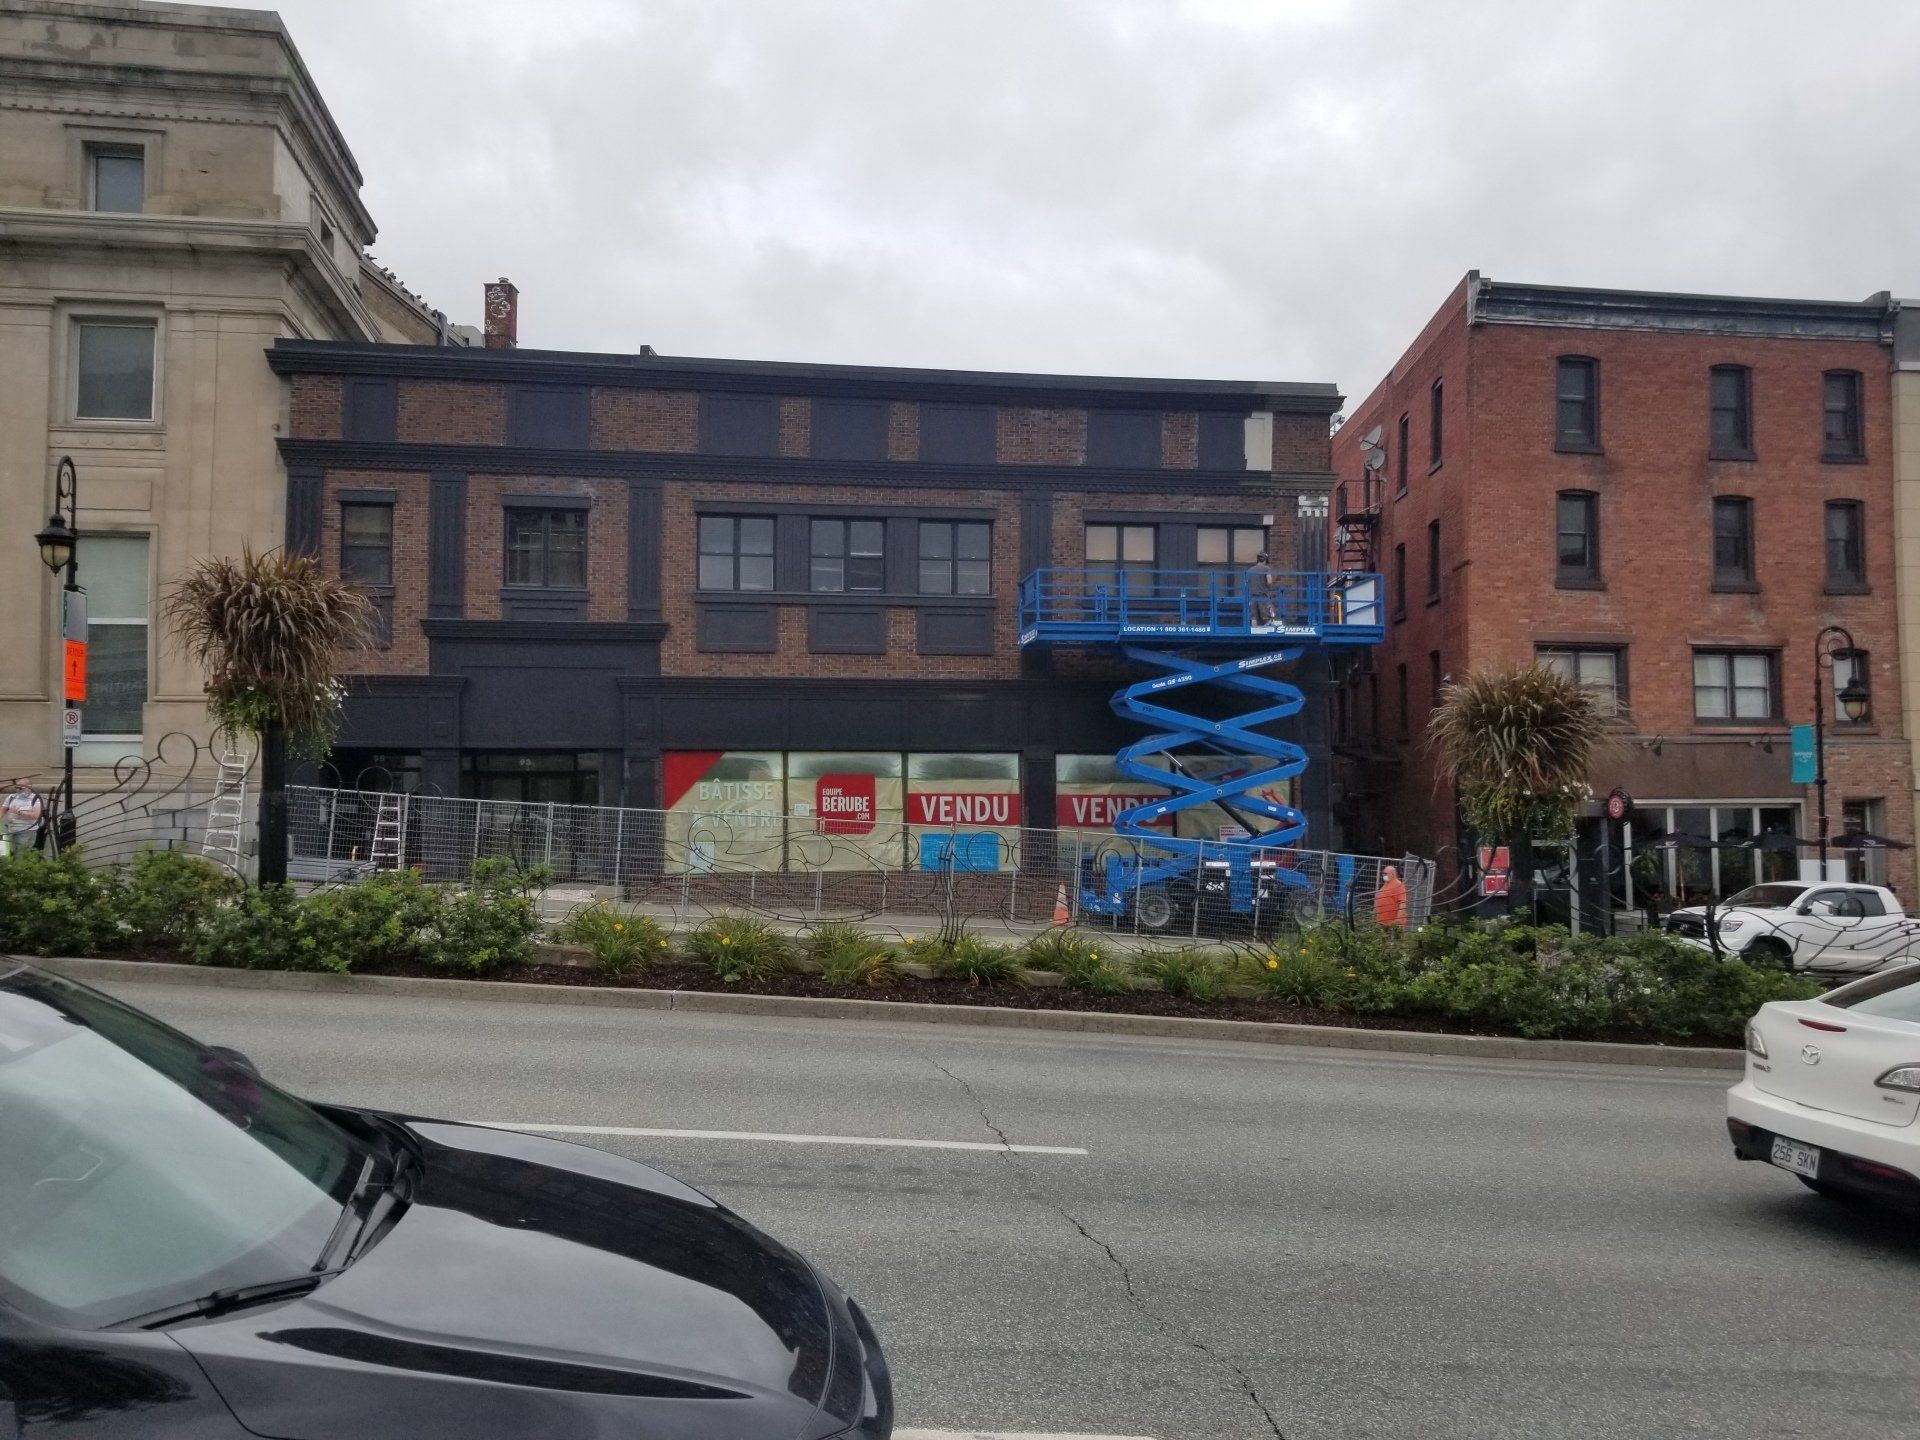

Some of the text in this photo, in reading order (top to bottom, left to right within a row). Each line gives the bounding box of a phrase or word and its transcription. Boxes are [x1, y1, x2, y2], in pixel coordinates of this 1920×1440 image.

[700, 778, 774, 800] BÂTISSE
[822, 788, 843, 796] EQUIPE
[822, 796, 870, 812] BERUBE
[920, 795, 1009, 822] VENDU
[1072, 797, 1158, 823] VEN
[1772, 1143, 1792, 1163] 256
[1796, 1151, 1817, 1171] SKN
